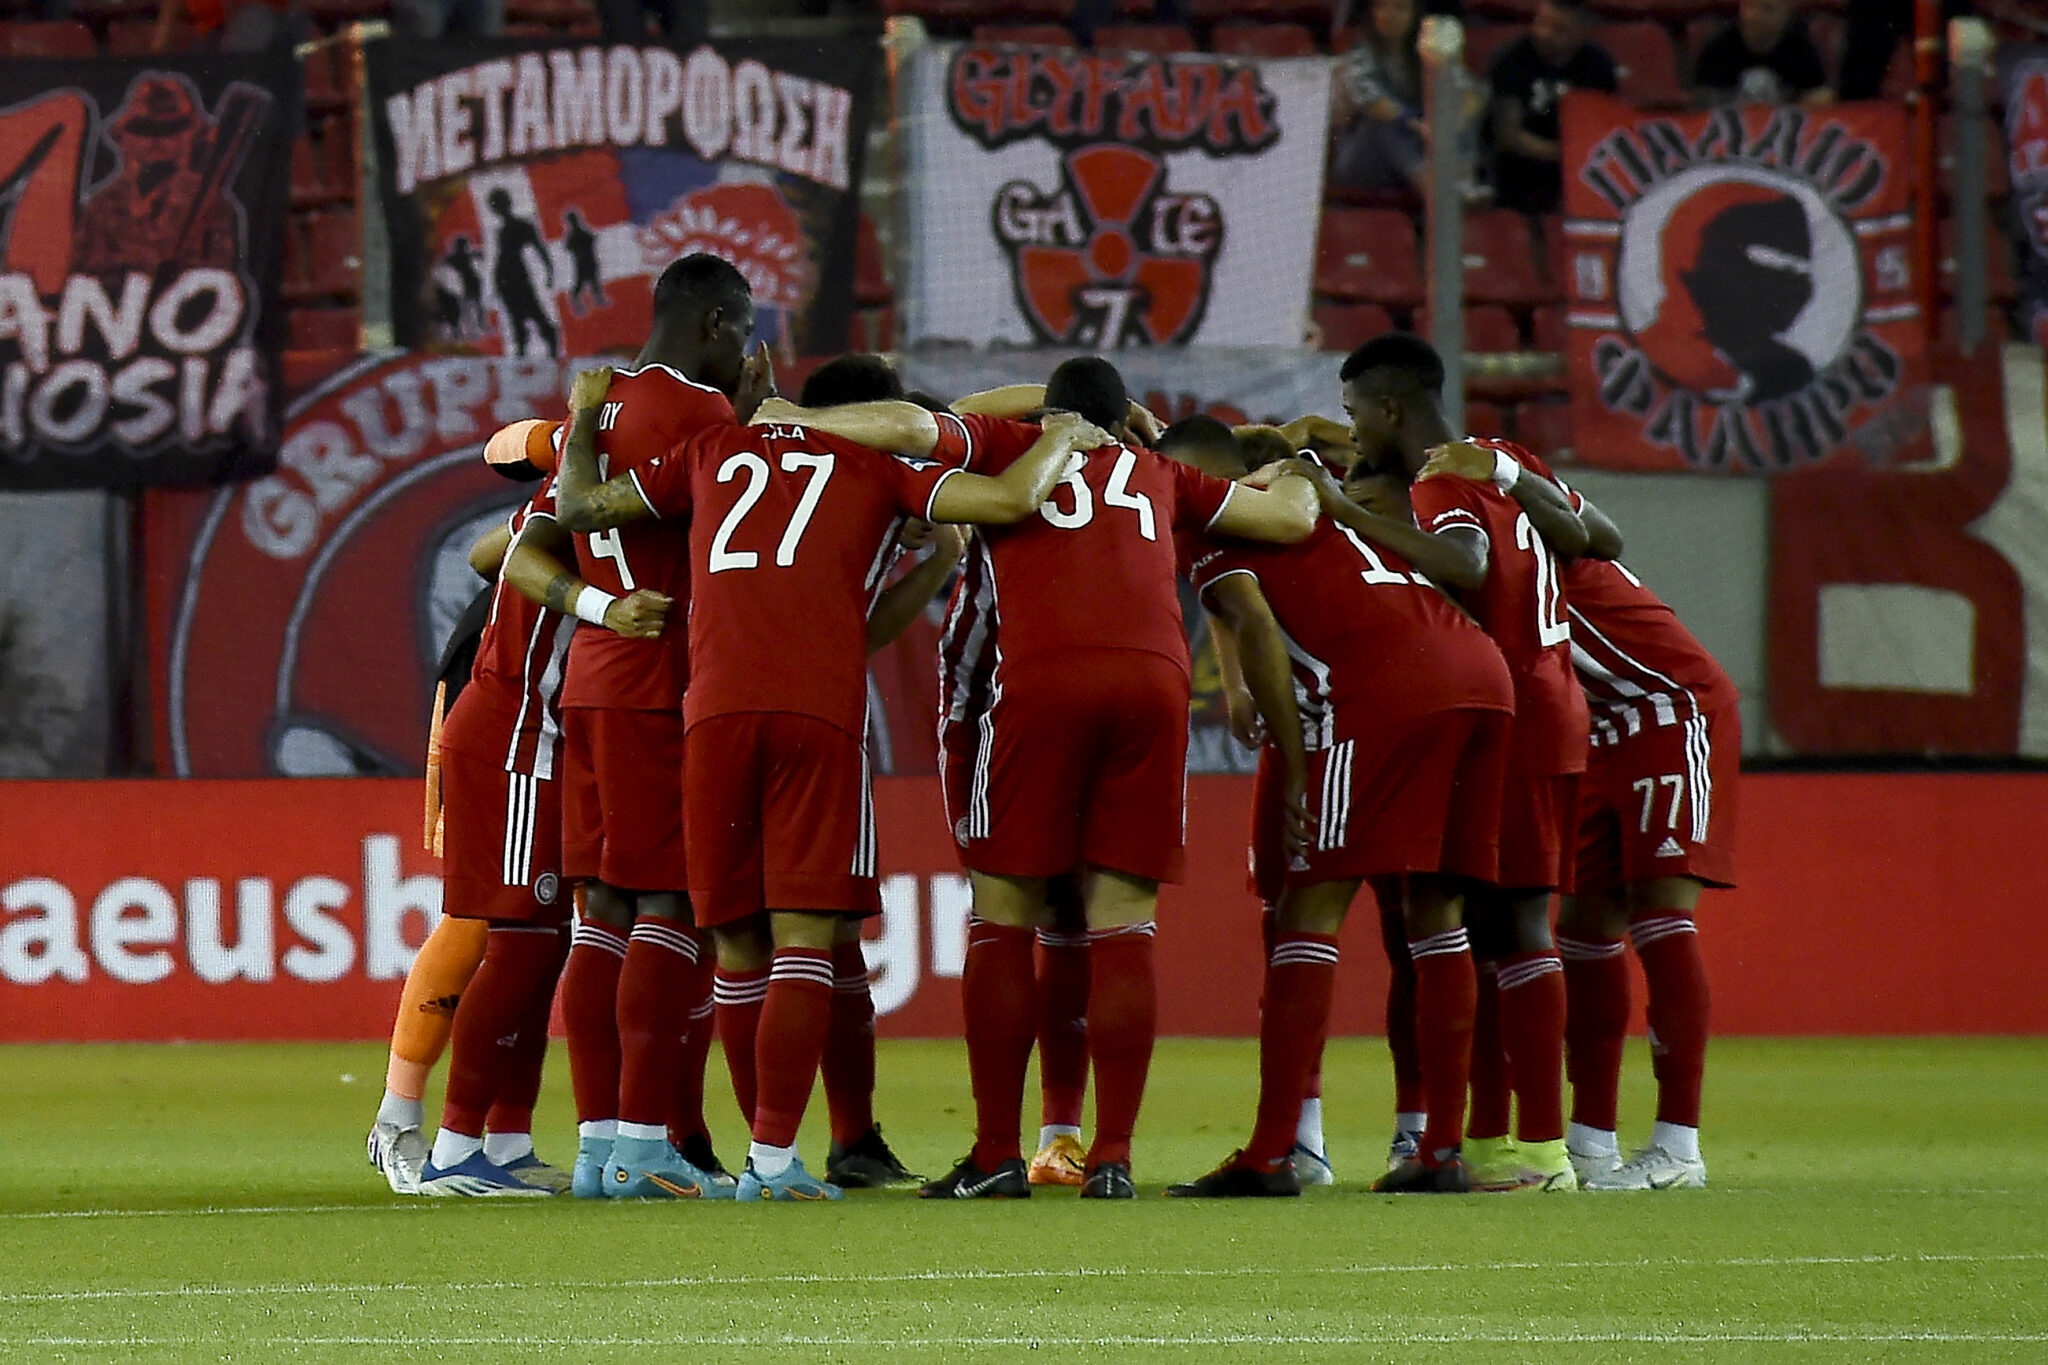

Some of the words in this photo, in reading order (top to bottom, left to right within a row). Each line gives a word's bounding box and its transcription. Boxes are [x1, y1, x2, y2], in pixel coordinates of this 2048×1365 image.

[387, 45, 851, 194] ΜΕΤΑΜΟΡΦΩΣΗ
[0, 348, 268, 446] IOSIA
[243, 355, 640, 558] GRUPP
[1040, 446, 1156, 541] 34
[709, 452, 834, 573] 27
[1632, 774, 1686, 834] 77
